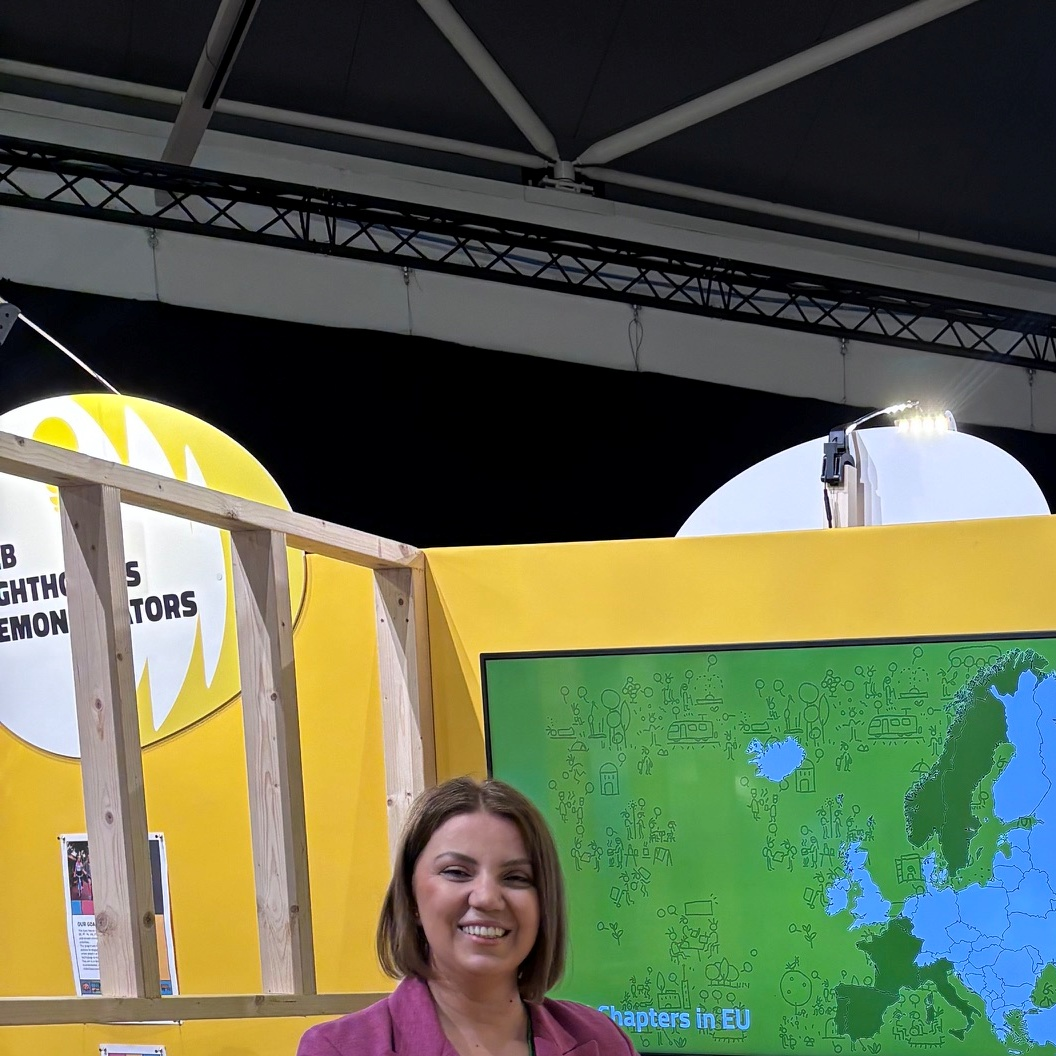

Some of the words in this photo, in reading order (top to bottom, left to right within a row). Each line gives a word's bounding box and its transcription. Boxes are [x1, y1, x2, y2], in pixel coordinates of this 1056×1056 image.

[0, 543, 17, 571] B
[696, 1006, 716, 1030] in
[721, 1008, 751, 1031] EU
